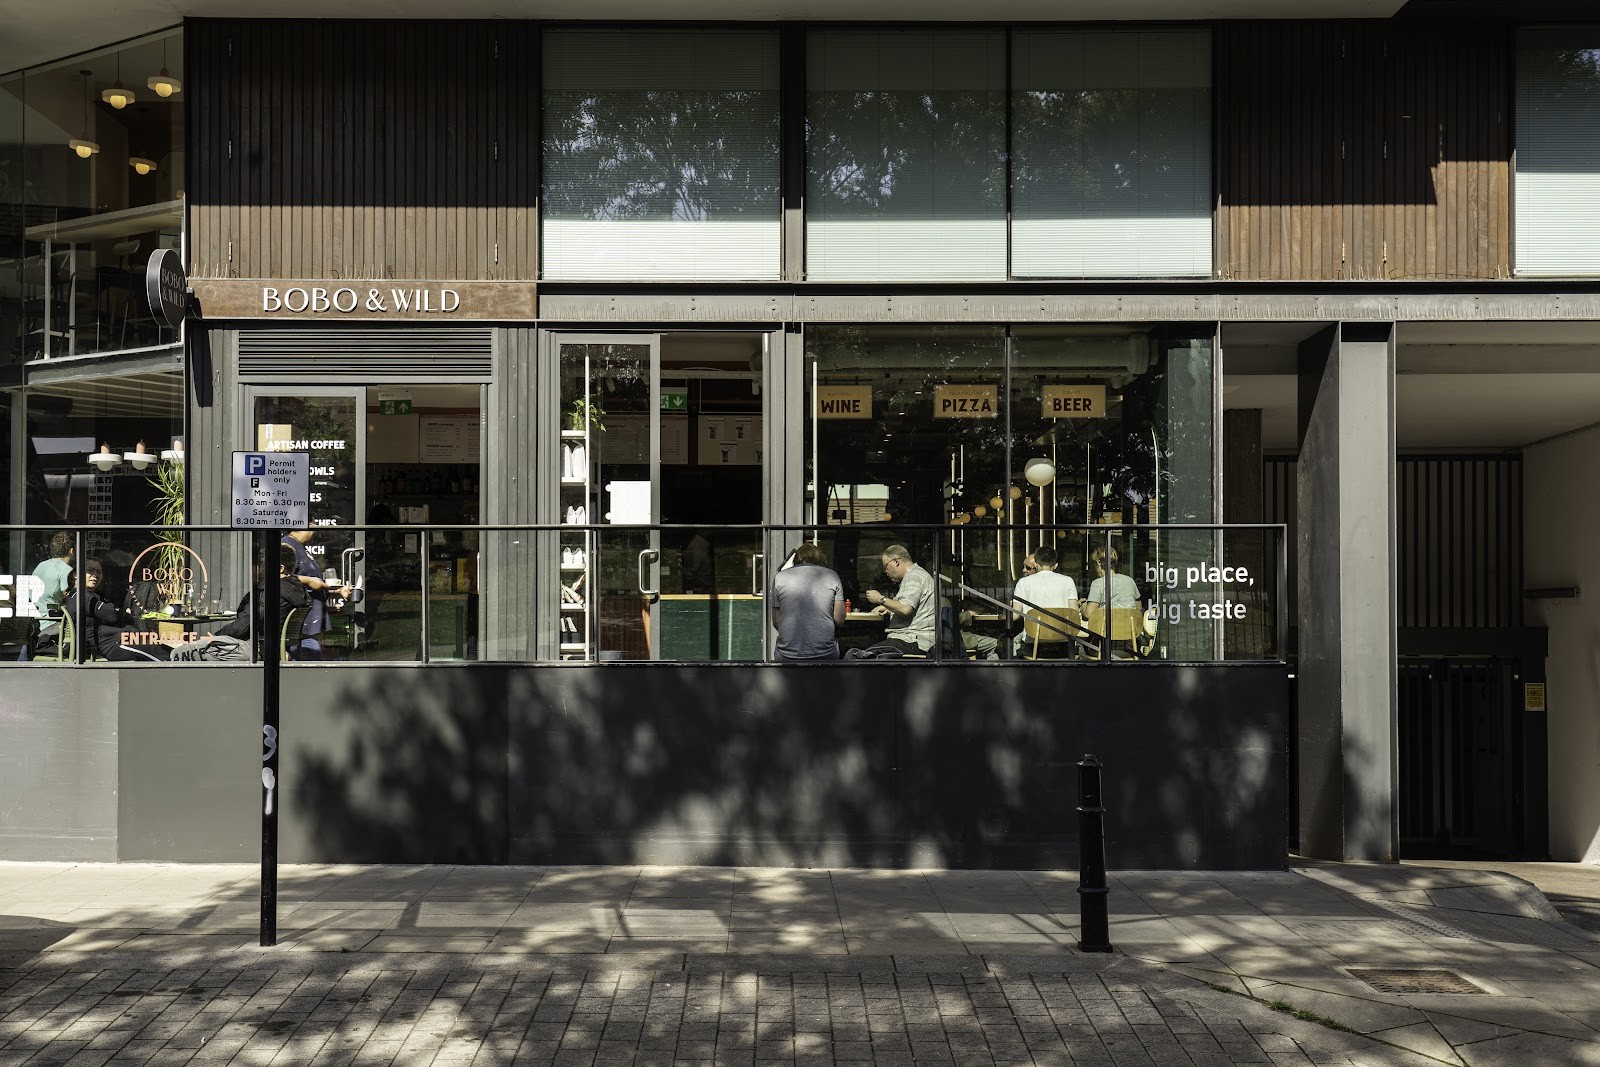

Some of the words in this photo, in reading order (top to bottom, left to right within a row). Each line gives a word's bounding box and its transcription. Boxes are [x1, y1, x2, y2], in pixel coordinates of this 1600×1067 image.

[162, 268, 184, 291] BOBO
[162, 287, 168, 301] &
[168, 289, 185, 308] WILD
[263, 287, 359, 313] BOBO
[365, 288, 388, 312] &
[391, 288, 460, 313] WILD
[821, 399, 861, 414] WINE
[942, 398, 992, 412] PIZZA
[1053, 397, 1092, 412] BEER
[267, 440, 309, 450] ARTISAN
[310, 440, 346, 450] COFFEE
[249, 456, 263, 474] P
[309, 466, 336, 476] OWLS
[252, 478, 259, 487] F
[235, 498, 254, 506] 8.30
[273, 498, 292, 506] 6.30
[252, 509, 288, 517] Saturday
[236, 517, 255, 525] 8.30
[142, 567, 194, 581] BOBO
[1145, 561, 1179, 588] big
[1186, 561, 1254, 588] place,
[1147, 598, 1181, 625] big
[1188, 599, 1247, 620] taste
[120, 631, 198, 645] ENTRANCE
